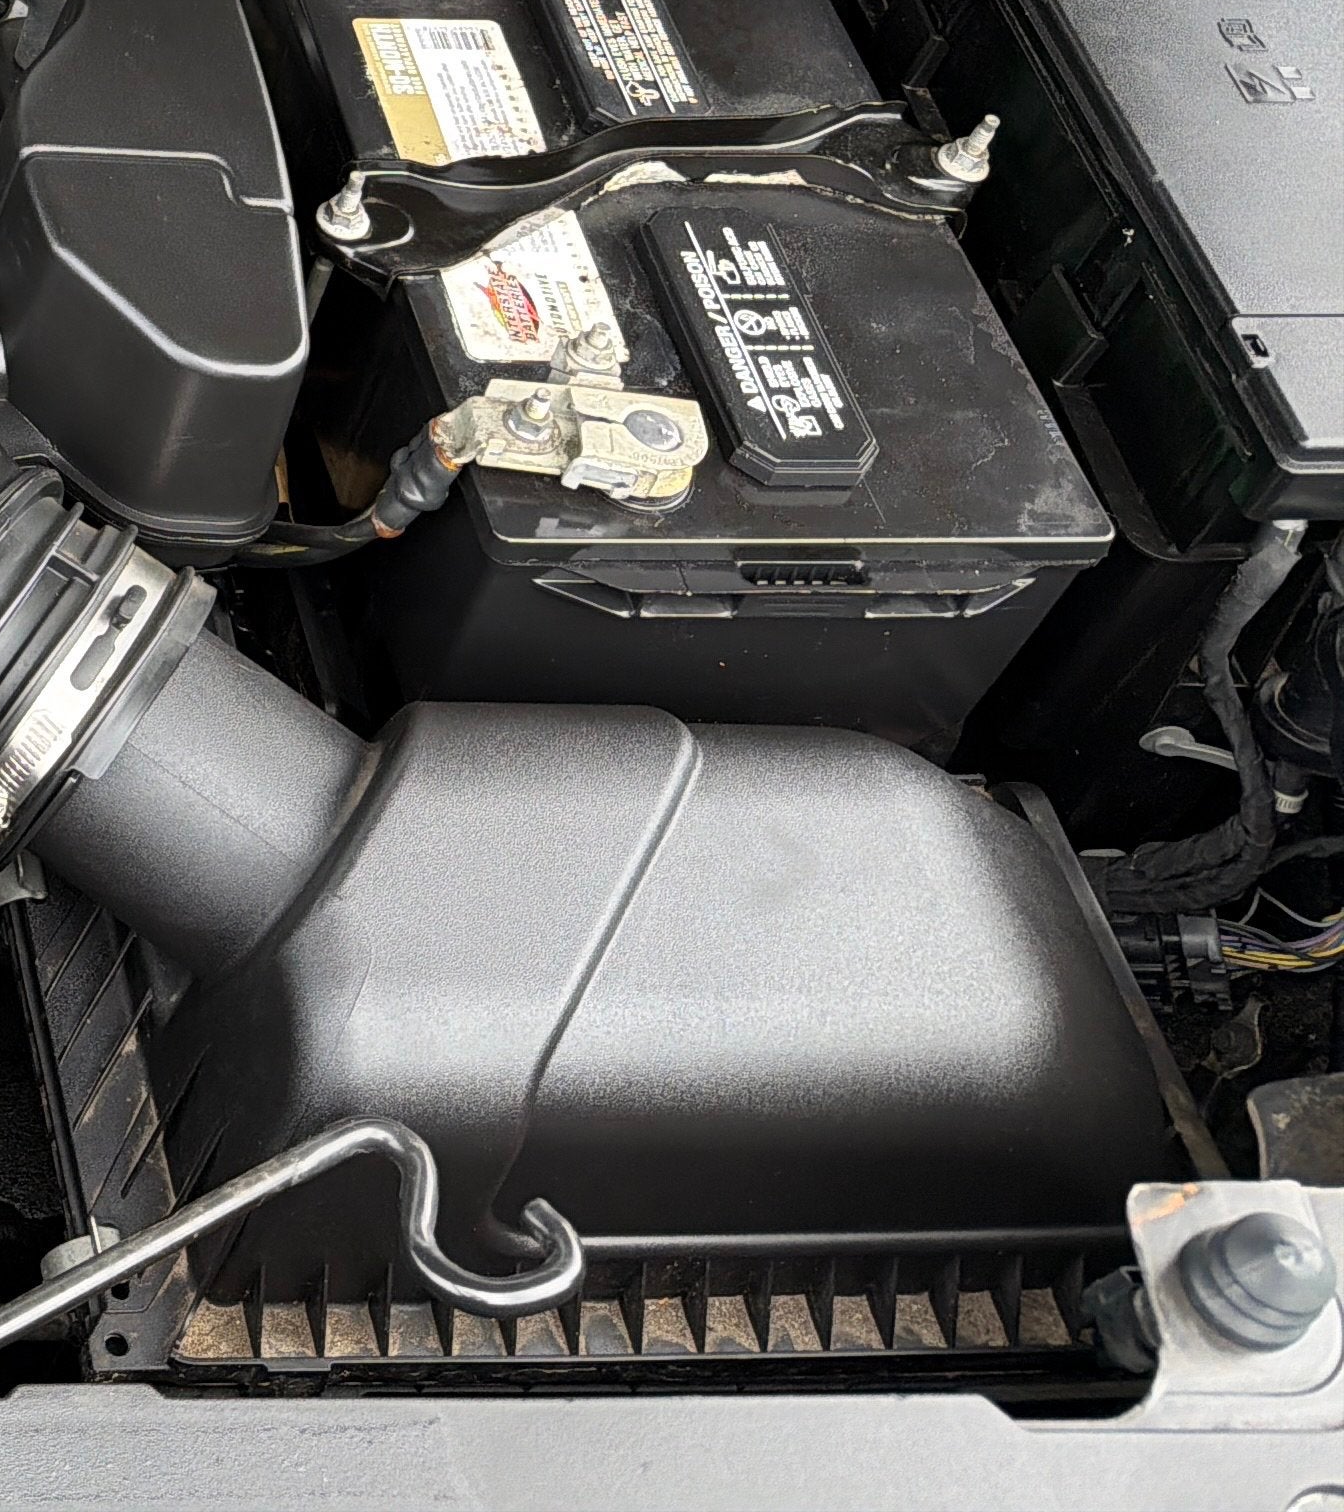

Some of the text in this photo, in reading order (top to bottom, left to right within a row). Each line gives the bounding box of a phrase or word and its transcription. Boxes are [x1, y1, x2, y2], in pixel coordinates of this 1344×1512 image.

[486, 267, 526, 343] INTERSTATE
[503, 273, 537, 341] BATTERIES
[680, 250, 721, 308] POISON
[714, 325, 759, 393] DANGER
